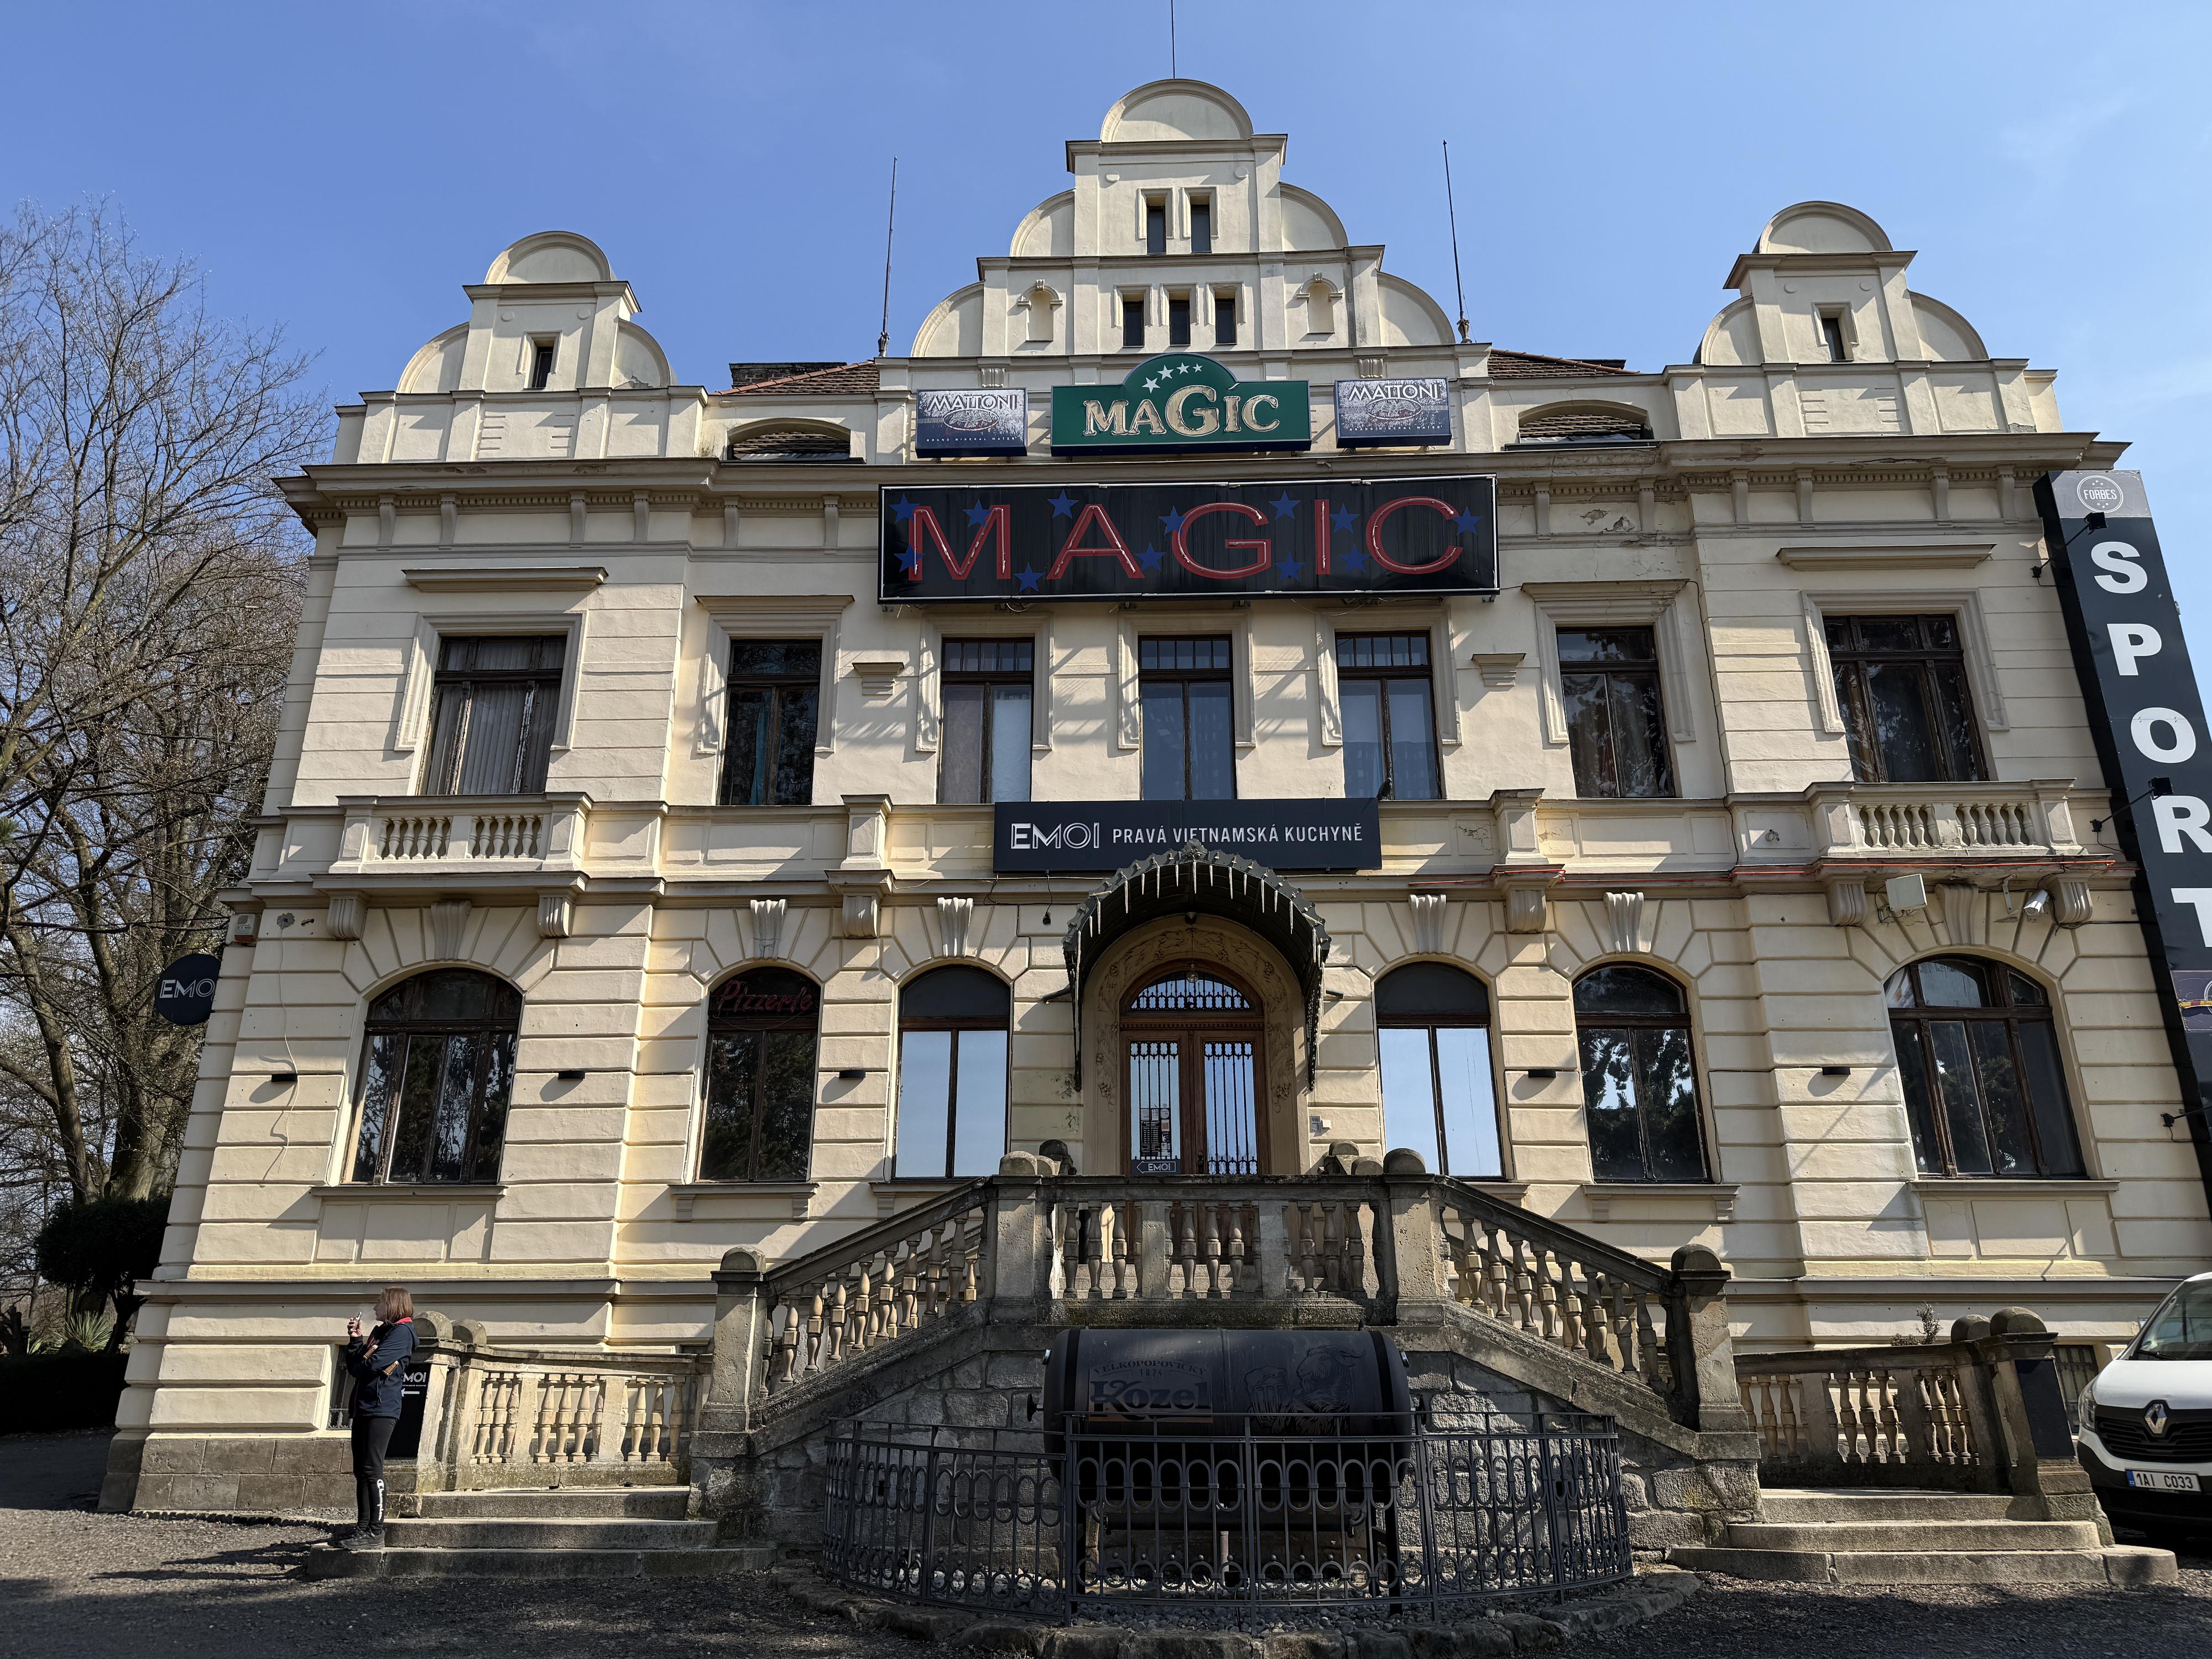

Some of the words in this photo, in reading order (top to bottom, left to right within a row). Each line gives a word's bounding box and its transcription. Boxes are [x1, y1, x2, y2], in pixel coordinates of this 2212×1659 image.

[1348, 384, 1438, 401] MATTONI
[928, 395, 1016, 411] MATTONI
[1082, 385, 1280, 437] MAGIC
[2083, 489, 2117, 500] FORBES
[908, 497, 1464, 581] MAGIC
[1011, 822, 1099, 849] EMOI
[1113, 825, 1166, 844] PRAVÁ
[1172, 824, 1278, 843] VIETNAMSKÁ
[1285, 823, 1363, 842] KUCHYNĚ
[159, 978, 215, 998] EMO
[1147, 1163, 1171, 1171] EMOI
[401, 1372, 426, 1383] MOI
[1140, 1369, 1162, 1377] 1874
[1090, 1380, 1211, 1421] Kozel
[2136, 1473, 2155, 1486] 1AI
[2164, 1475, 2193, 1489] C033
